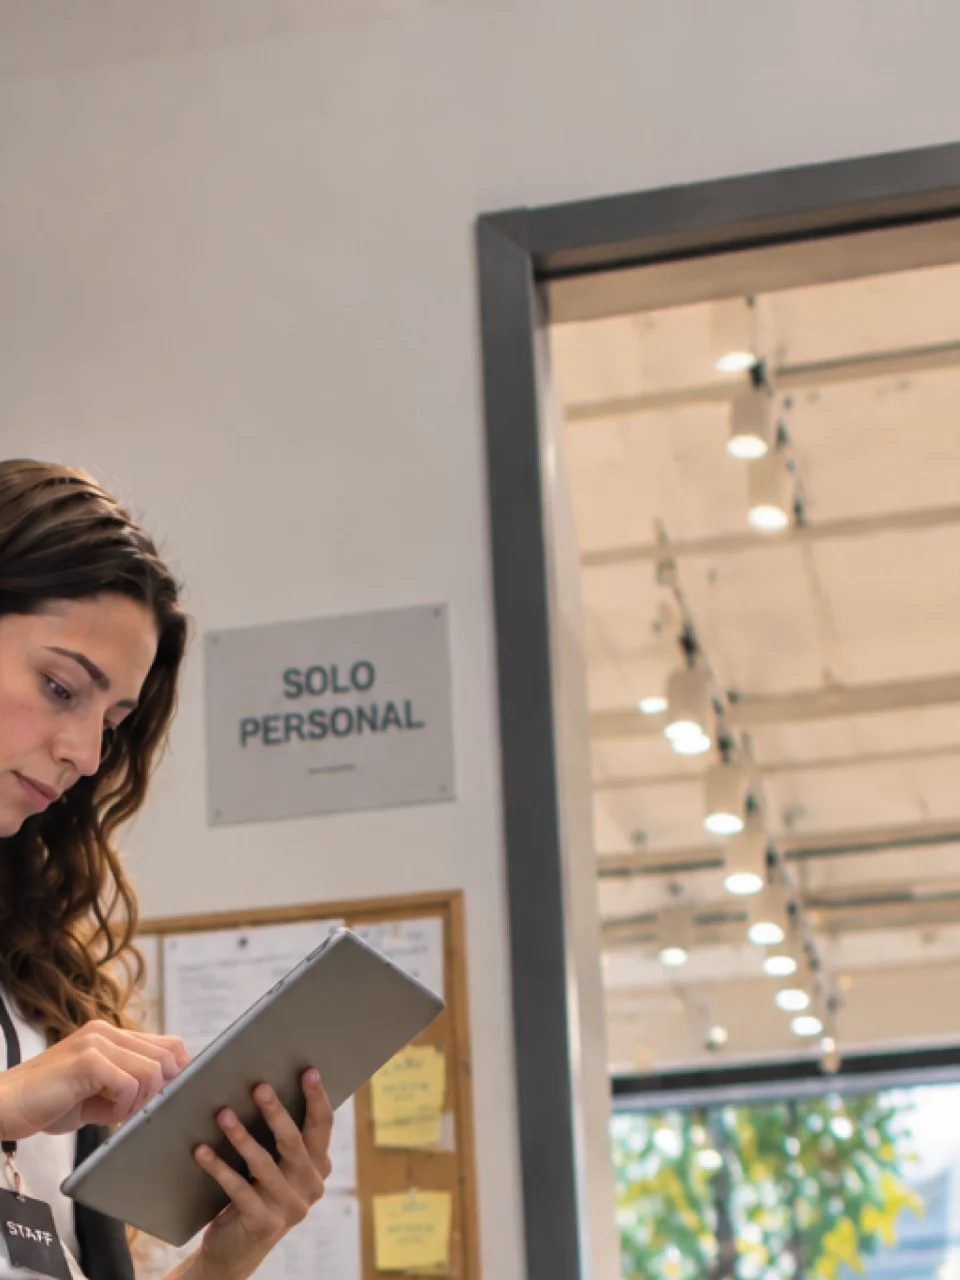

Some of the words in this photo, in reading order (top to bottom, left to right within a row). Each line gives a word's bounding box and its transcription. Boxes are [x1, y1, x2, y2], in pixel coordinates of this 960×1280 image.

[283, 660, 376, 700] SOLO
[240, 699, 426, 747] PERSONAL
[6, 1221, 53, 1246] STAFF
